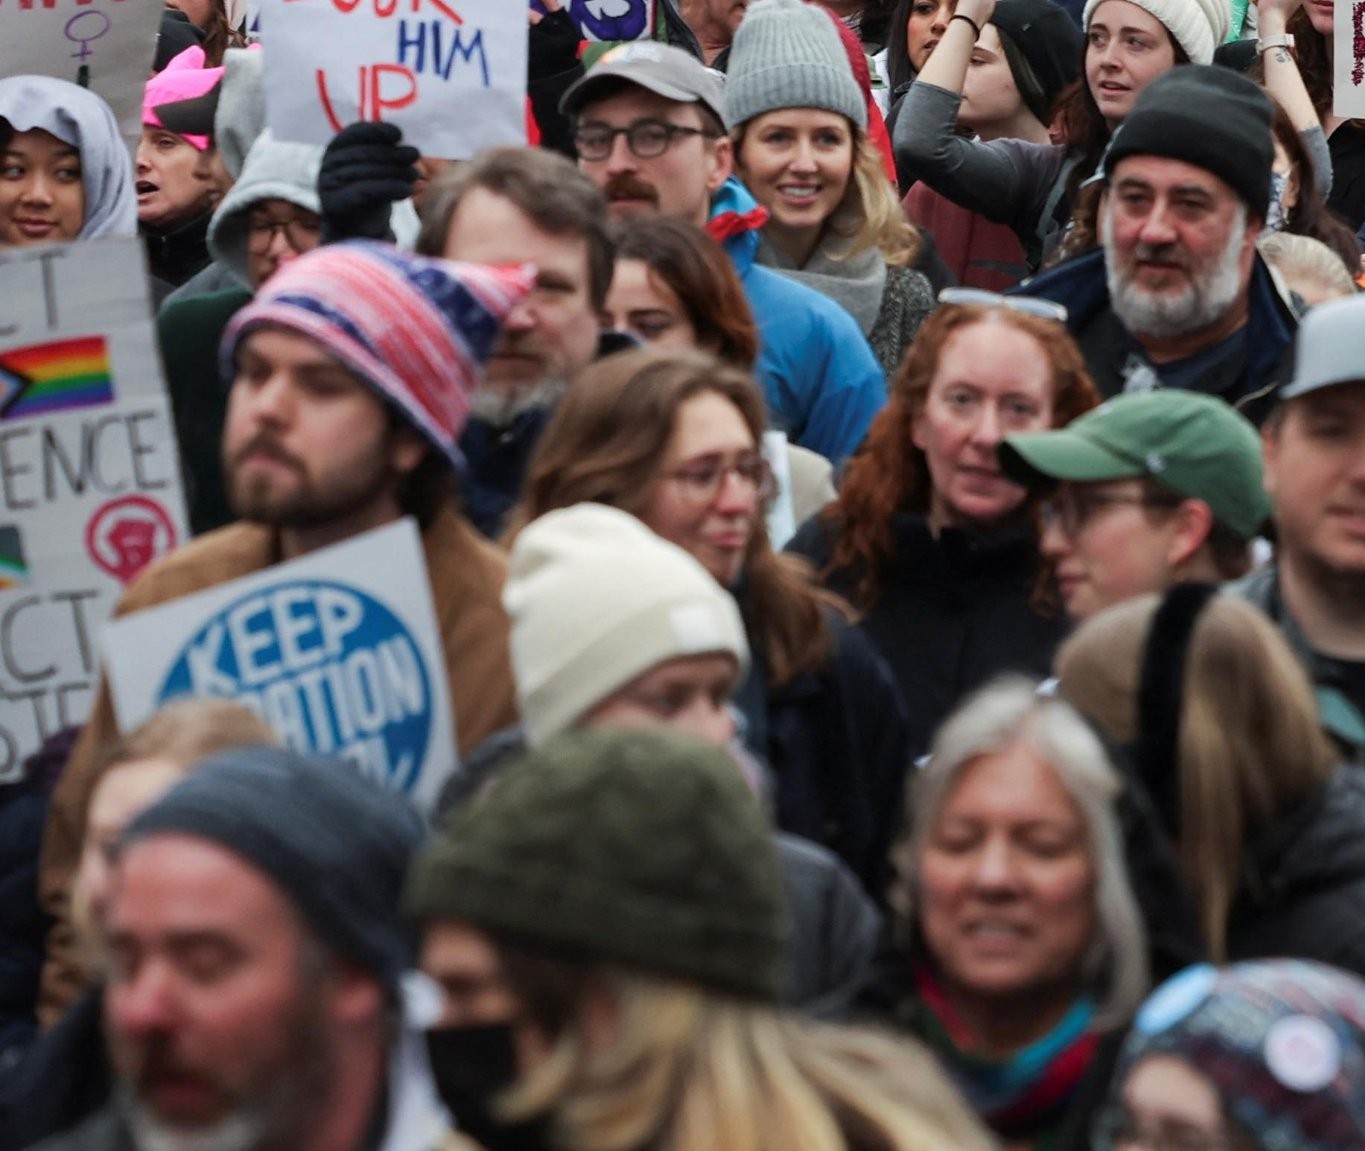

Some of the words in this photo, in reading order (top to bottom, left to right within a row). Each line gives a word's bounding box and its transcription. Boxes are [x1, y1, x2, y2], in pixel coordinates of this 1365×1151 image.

[397, 19, 491, 87] HIM
[316, 63, 417, 134] UP
[186, 587, 363, 691] KEEP
